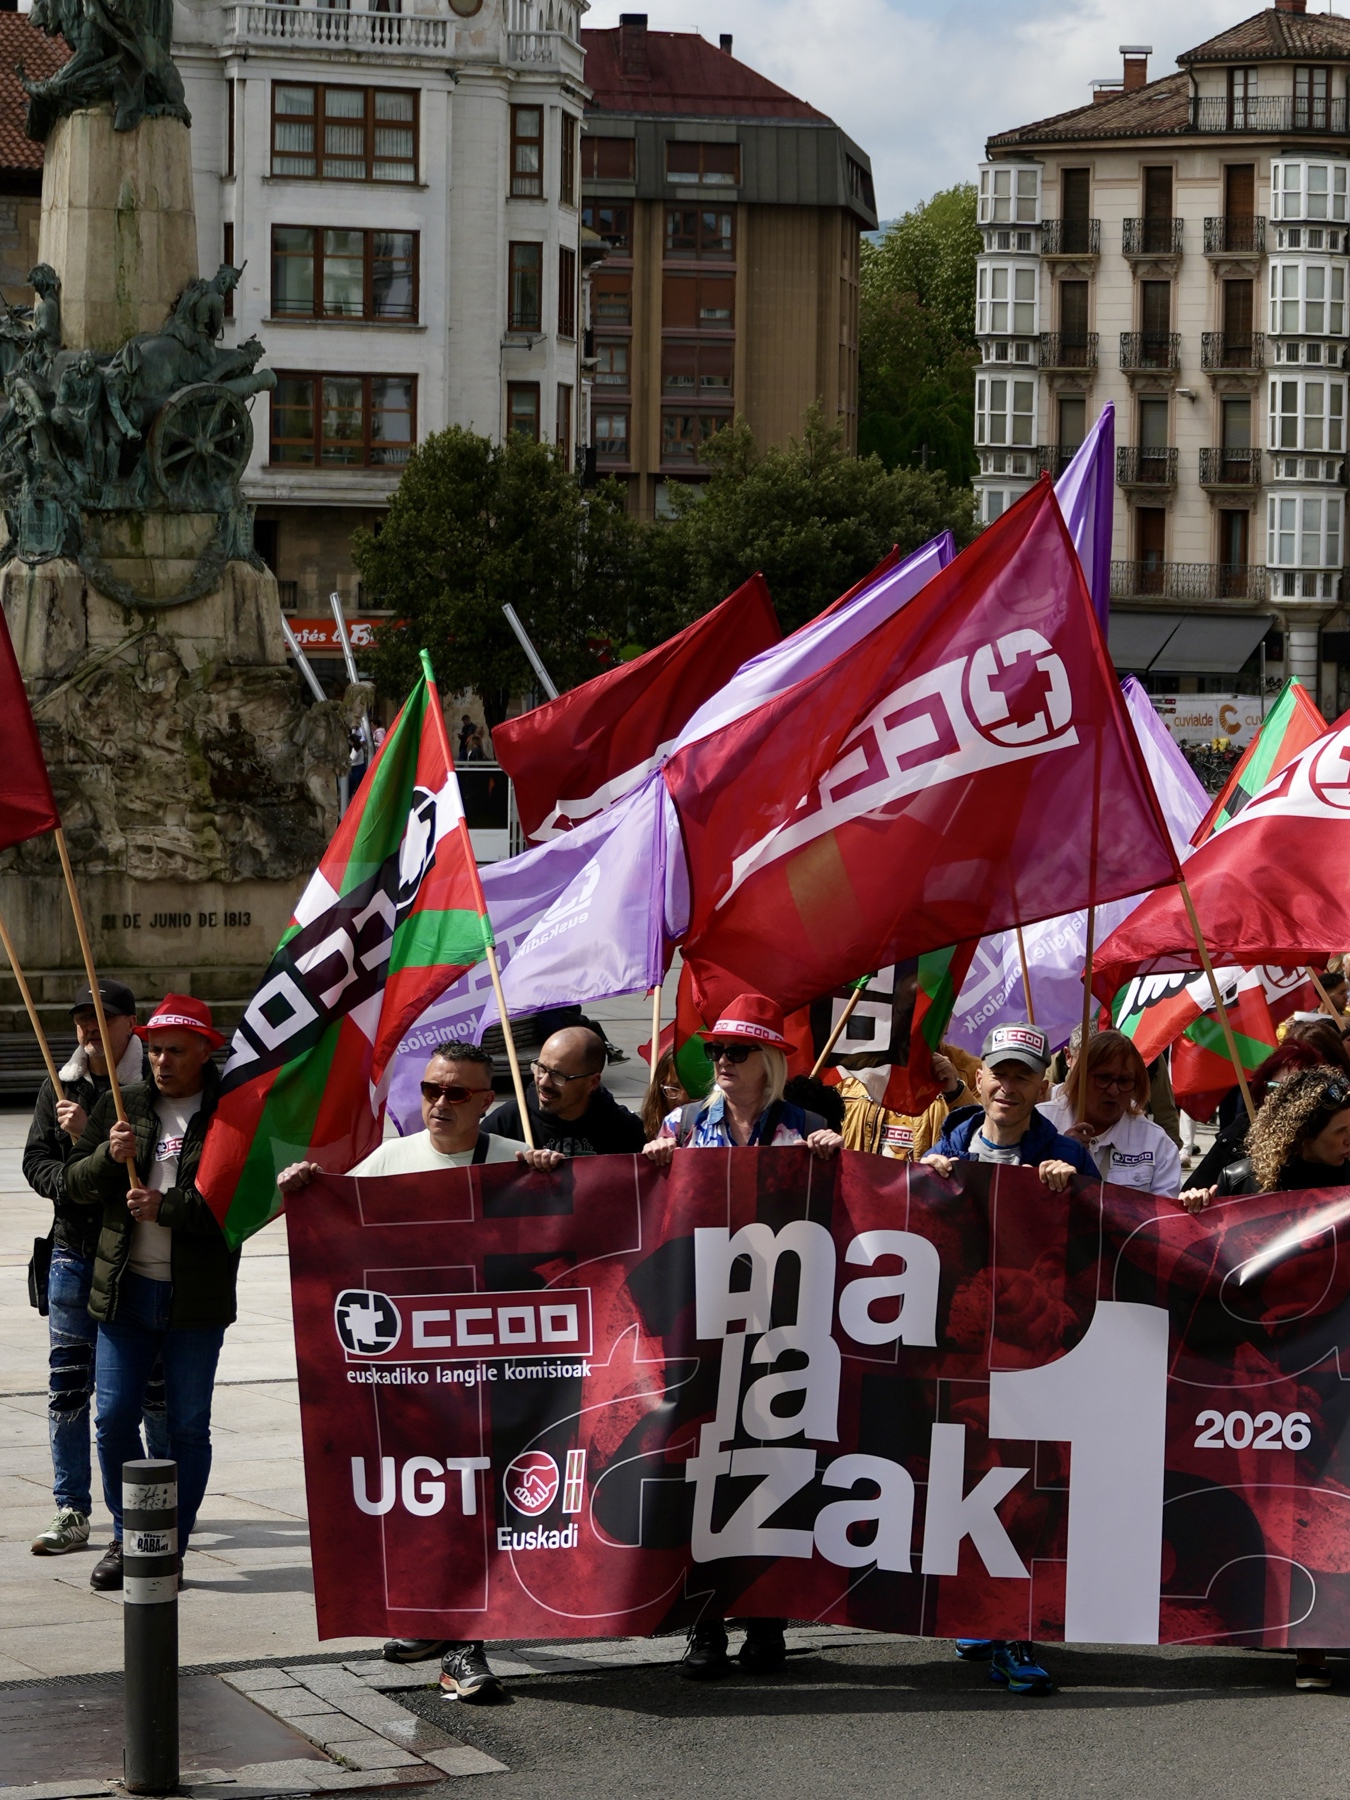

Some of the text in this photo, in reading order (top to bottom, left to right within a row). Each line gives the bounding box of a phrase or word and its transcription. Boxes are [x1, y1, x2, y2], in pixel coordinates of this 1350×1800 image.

[1174, 712, 1213, 727] cuvialde
[123, 914, 141, 928] DE
[149, 913, 192, 928] JUNIO
[199, 912, 217, 927] DE
[224, 911, 252, 927] 1813
[735, 1023, 769, 1039] CCOO
[1007, 1031, 1041, 1047] CCOO
[1124, 1152, 1152, 1163] CCOO
[411, 1303, 579, 1349] CCOO
[346, 1361, 592, 1387] euskadiko langile komisioak
[1194, 1409, 1311, 1451] 2026
[988, 1300, 1169, 1645] 1
[350, 1456, 491, 1518] UGT
[685, 1422, 1032, 1580] tzak
[497, 1522, 579, 1551] Euskadi
